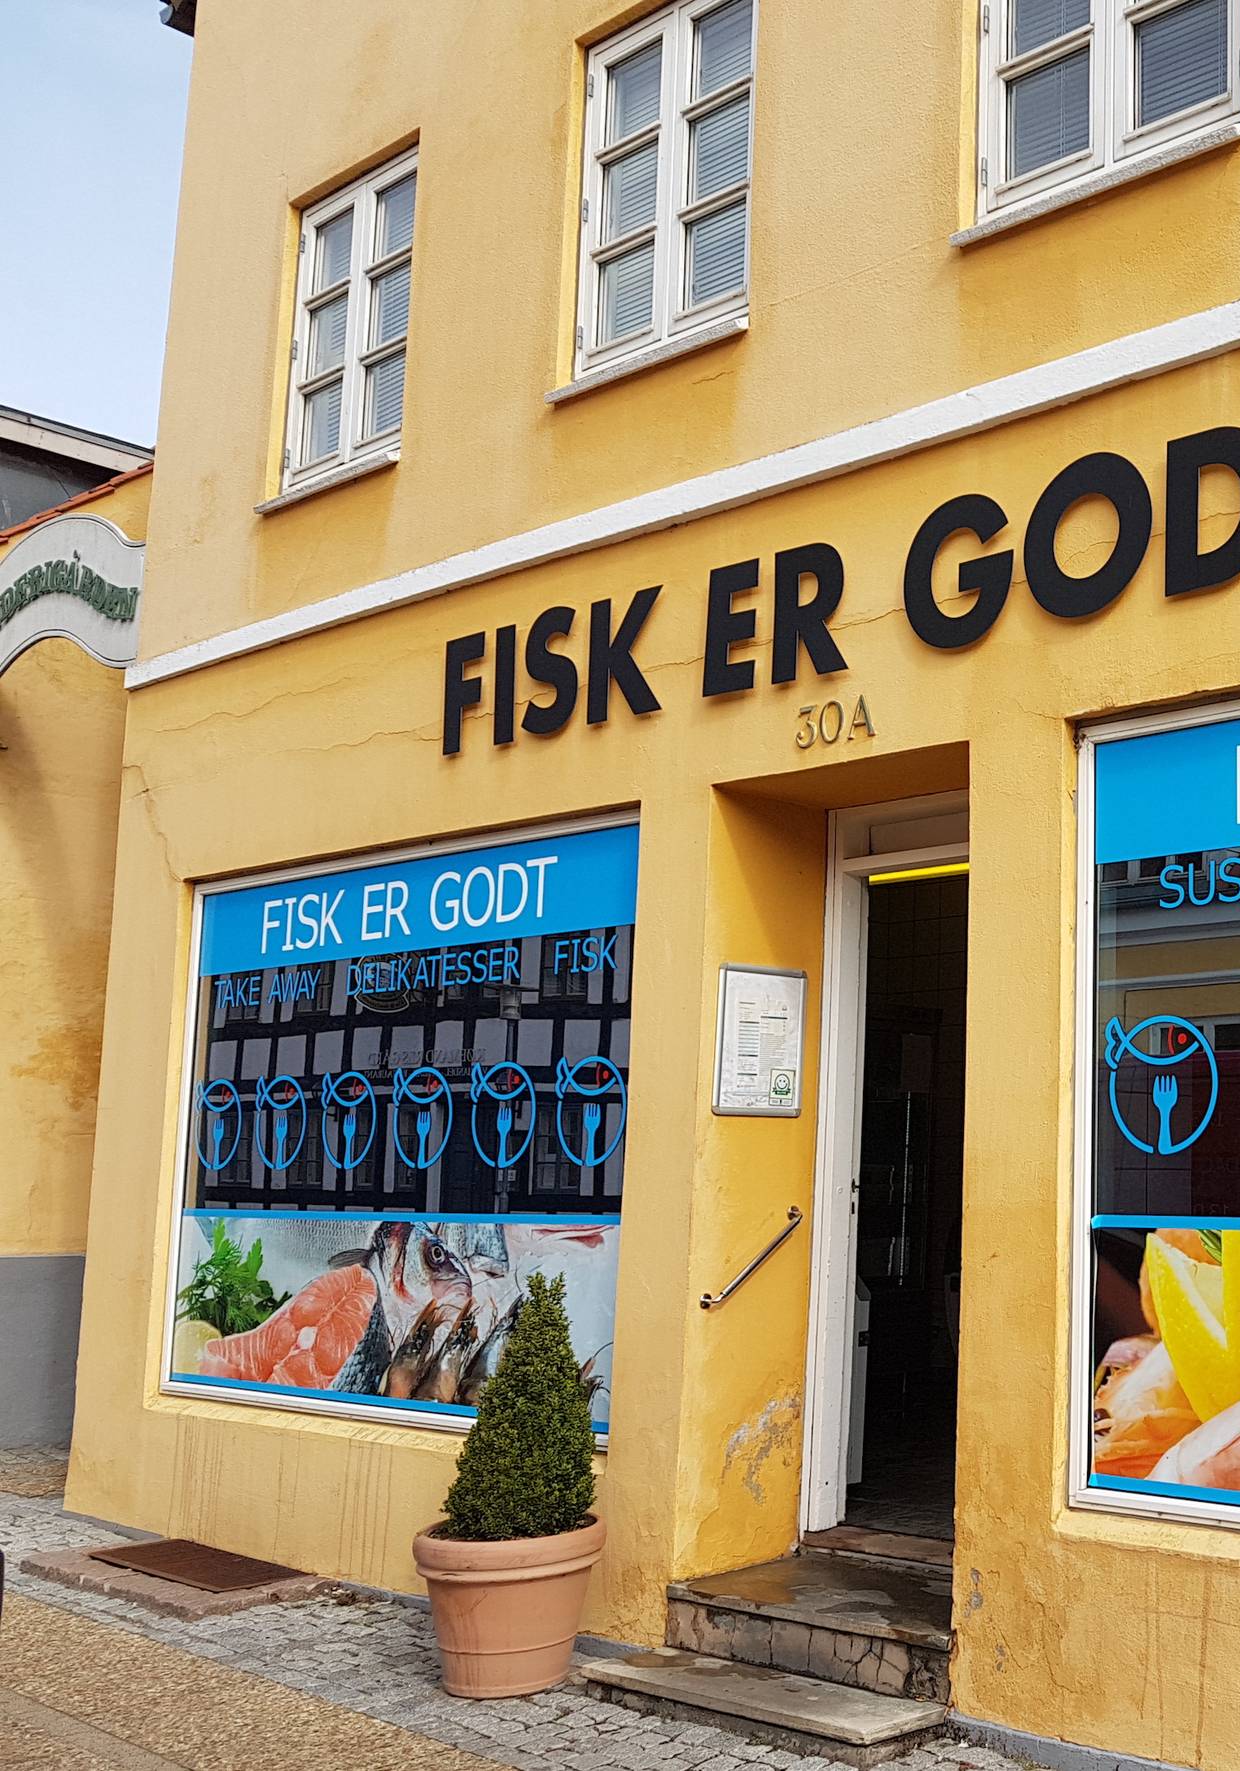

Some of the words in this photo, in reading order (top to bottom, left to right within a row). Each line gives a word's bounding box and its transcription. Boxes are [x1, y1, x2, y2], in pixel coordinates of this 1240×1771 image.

[443, 586, 663, 756] FISK
[702, 542, 849, 698] ER
[795, 694, 876, 749] 30A
[261, 889, 344, 954] FISK
[361, 881, 411, 941] ER
[429, 856, 558, 932] GODT
[214, 976, 260, 1009] TAKE
[268, 969, 321, 1004] AWAY
[345, 946, 520, 997] DELIKATESSER
[554, 934, 619, 976] FISK
